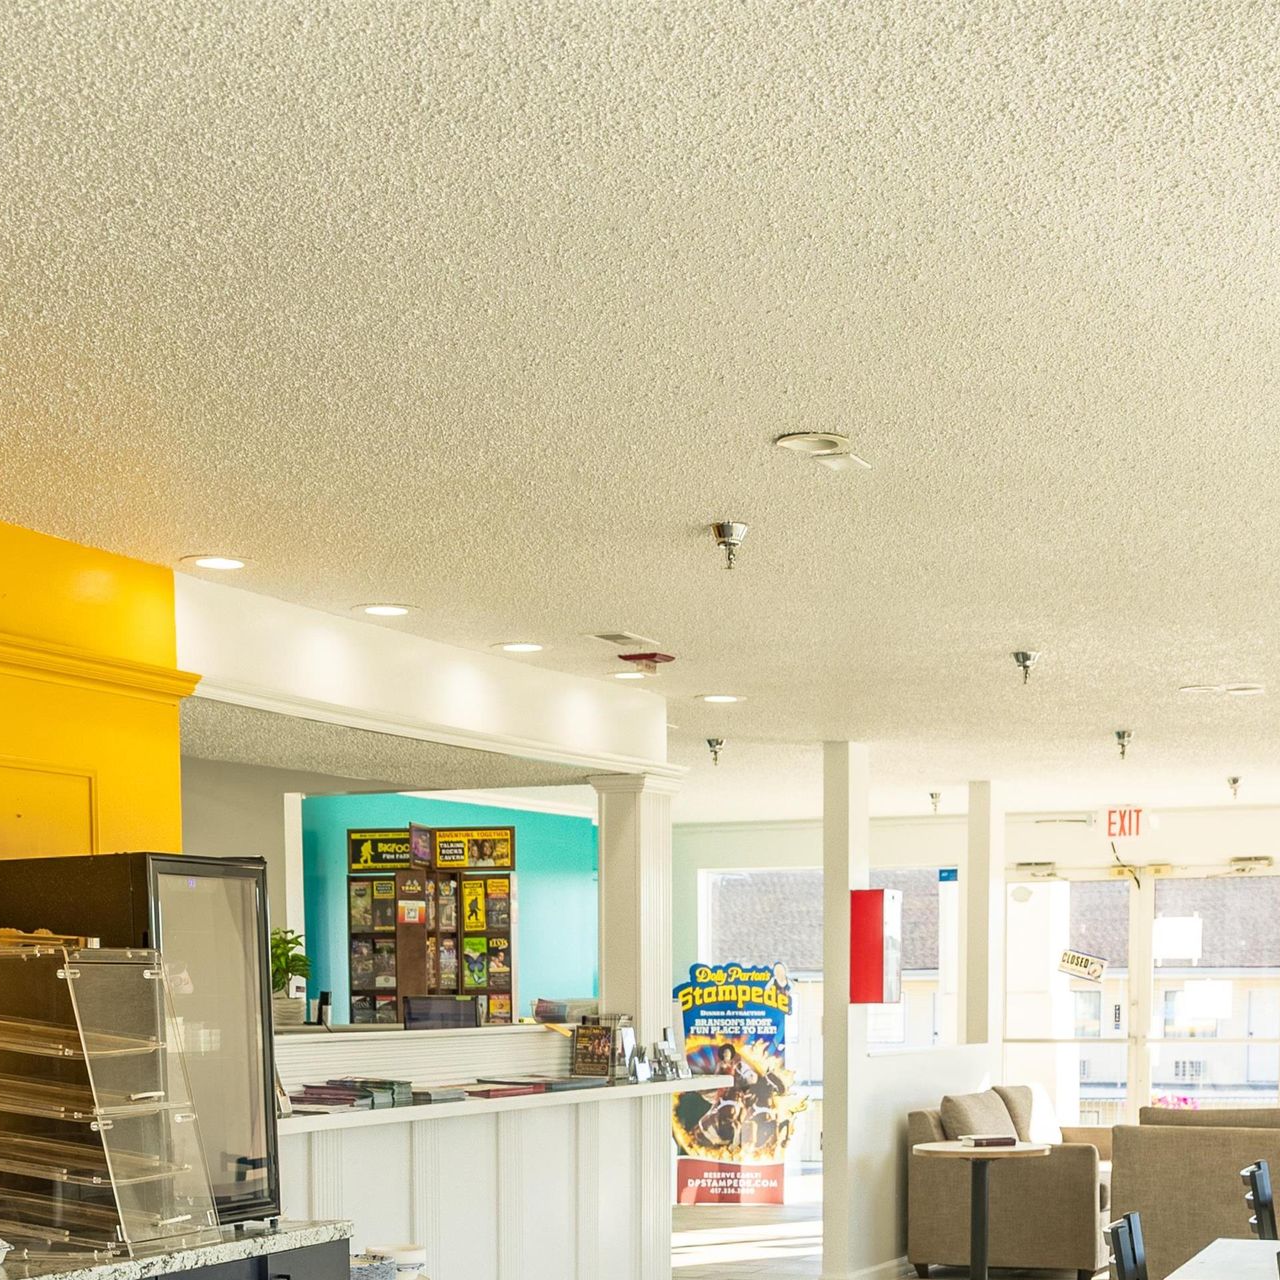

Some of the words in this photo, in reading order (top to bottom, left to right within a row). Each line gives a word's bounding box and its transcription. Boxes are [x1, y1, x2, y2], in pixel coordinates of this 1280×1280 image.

[1106, 808, 1143, 837] EXIT
[378, 843, 410, 853] BIGFOO
[1061, 952, 1090, 969] CLOSED
[695, 967, 727, 985] Dolly
[728, 966, 771, 982] Parton's
[678, 984, 790, 1013] Stampede
[695, 1018, 745, 1026] BRANSON'S
[746, 1018, 772, 1026] MOST
[690, 1026, 709, 1034] FUN
[710, 1026, 740, 1034] PLACE
[742, 1026, 755, 1034] TO
[703, 1171, 735, 1179] RESERVE
